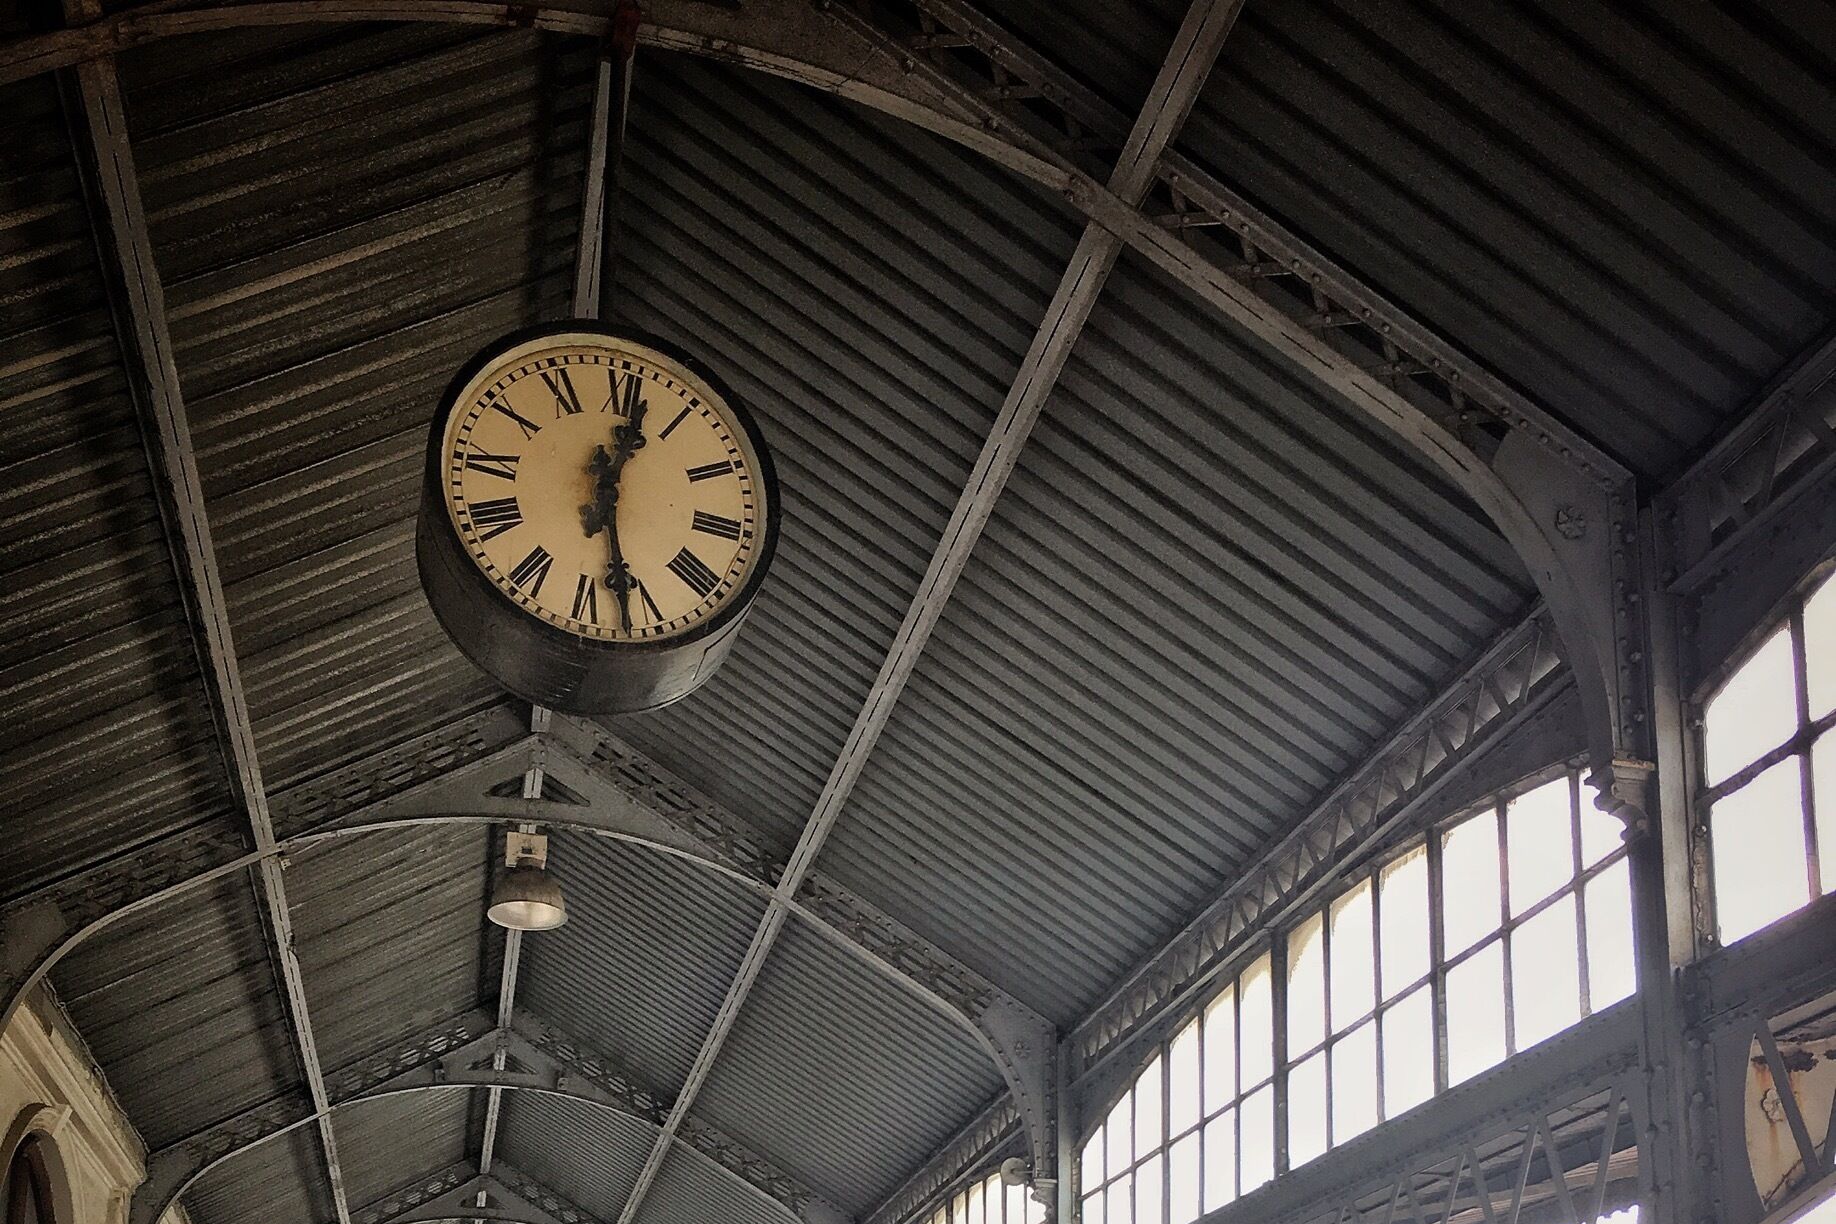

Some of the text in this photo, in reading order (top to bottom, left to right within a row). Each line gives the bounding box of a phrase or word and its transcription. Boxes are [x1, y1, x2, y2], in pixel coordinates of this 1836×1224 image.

[539, 367, 584, 419] XI
[600, 367, 643, 419] XII
[490, 393, 542, 441] X
[657, 404, 695, 441] I
[465, 441, 520, 483] IX
[684, 459, 736, 484] II
[467, 496, 524, 543] VIII
[691, 509, 742, 543] III
[508, 545, 554, 599] VII
[665, 545, 722, 600] IIII
[571, 573, 598, 625] VI
[638, 578, 666, 625] V
